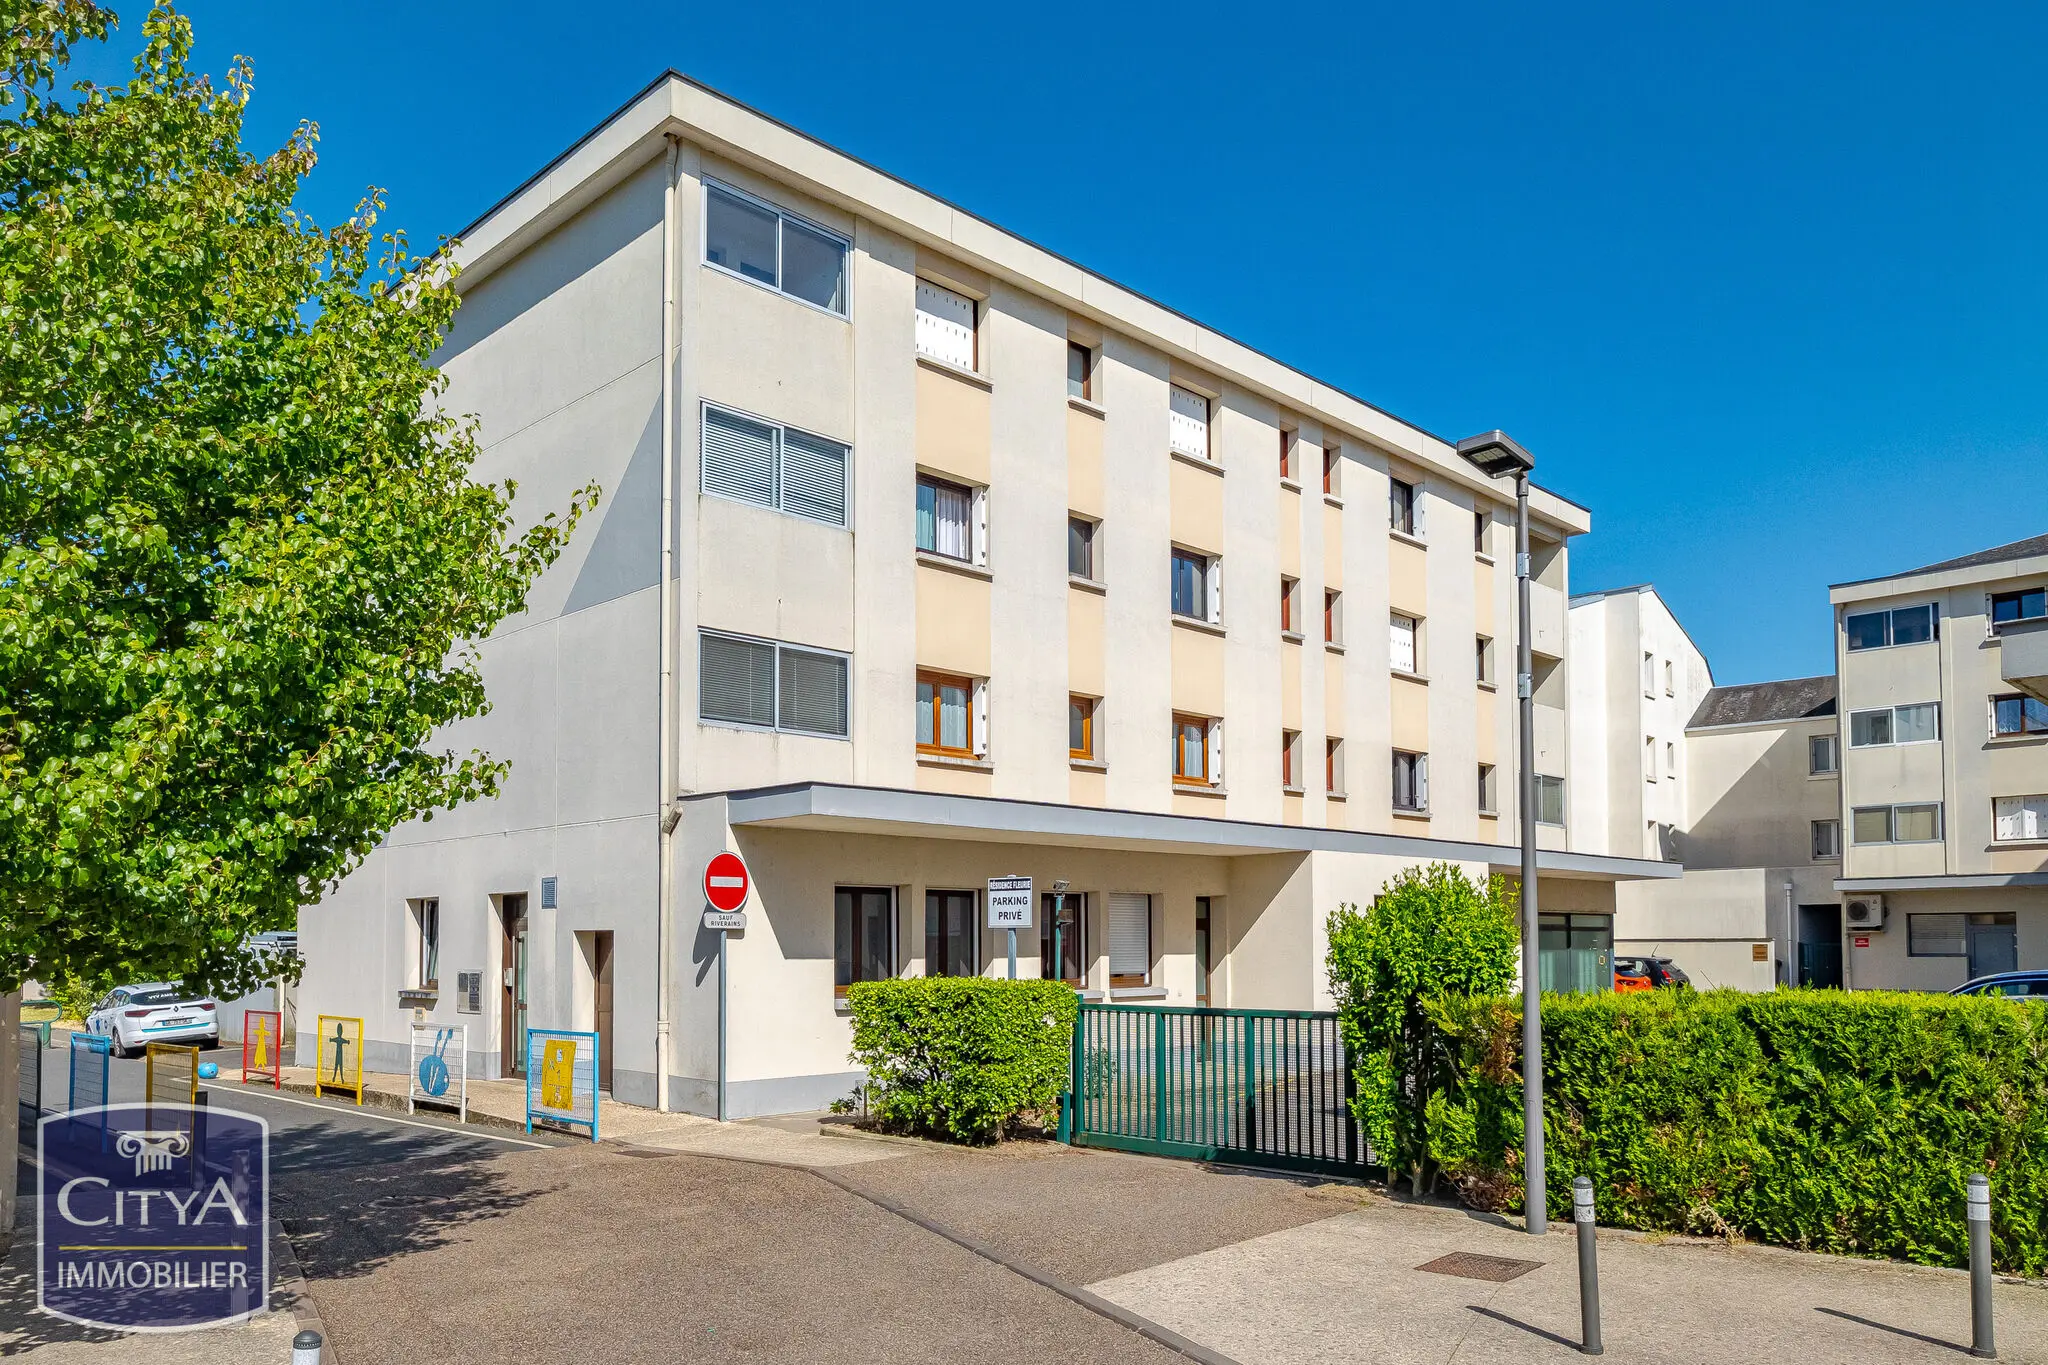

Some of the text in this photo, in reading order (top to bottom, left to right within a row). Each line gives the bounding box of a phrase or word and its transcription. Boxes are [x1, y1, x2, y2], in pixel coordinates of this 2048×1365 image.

[990, 880, 1031, 889] RÉSIDENCE FLEURIE
[992, 896, 1028, 906] PARKING
[998, 909, 1022, 920] PRIVÉ
